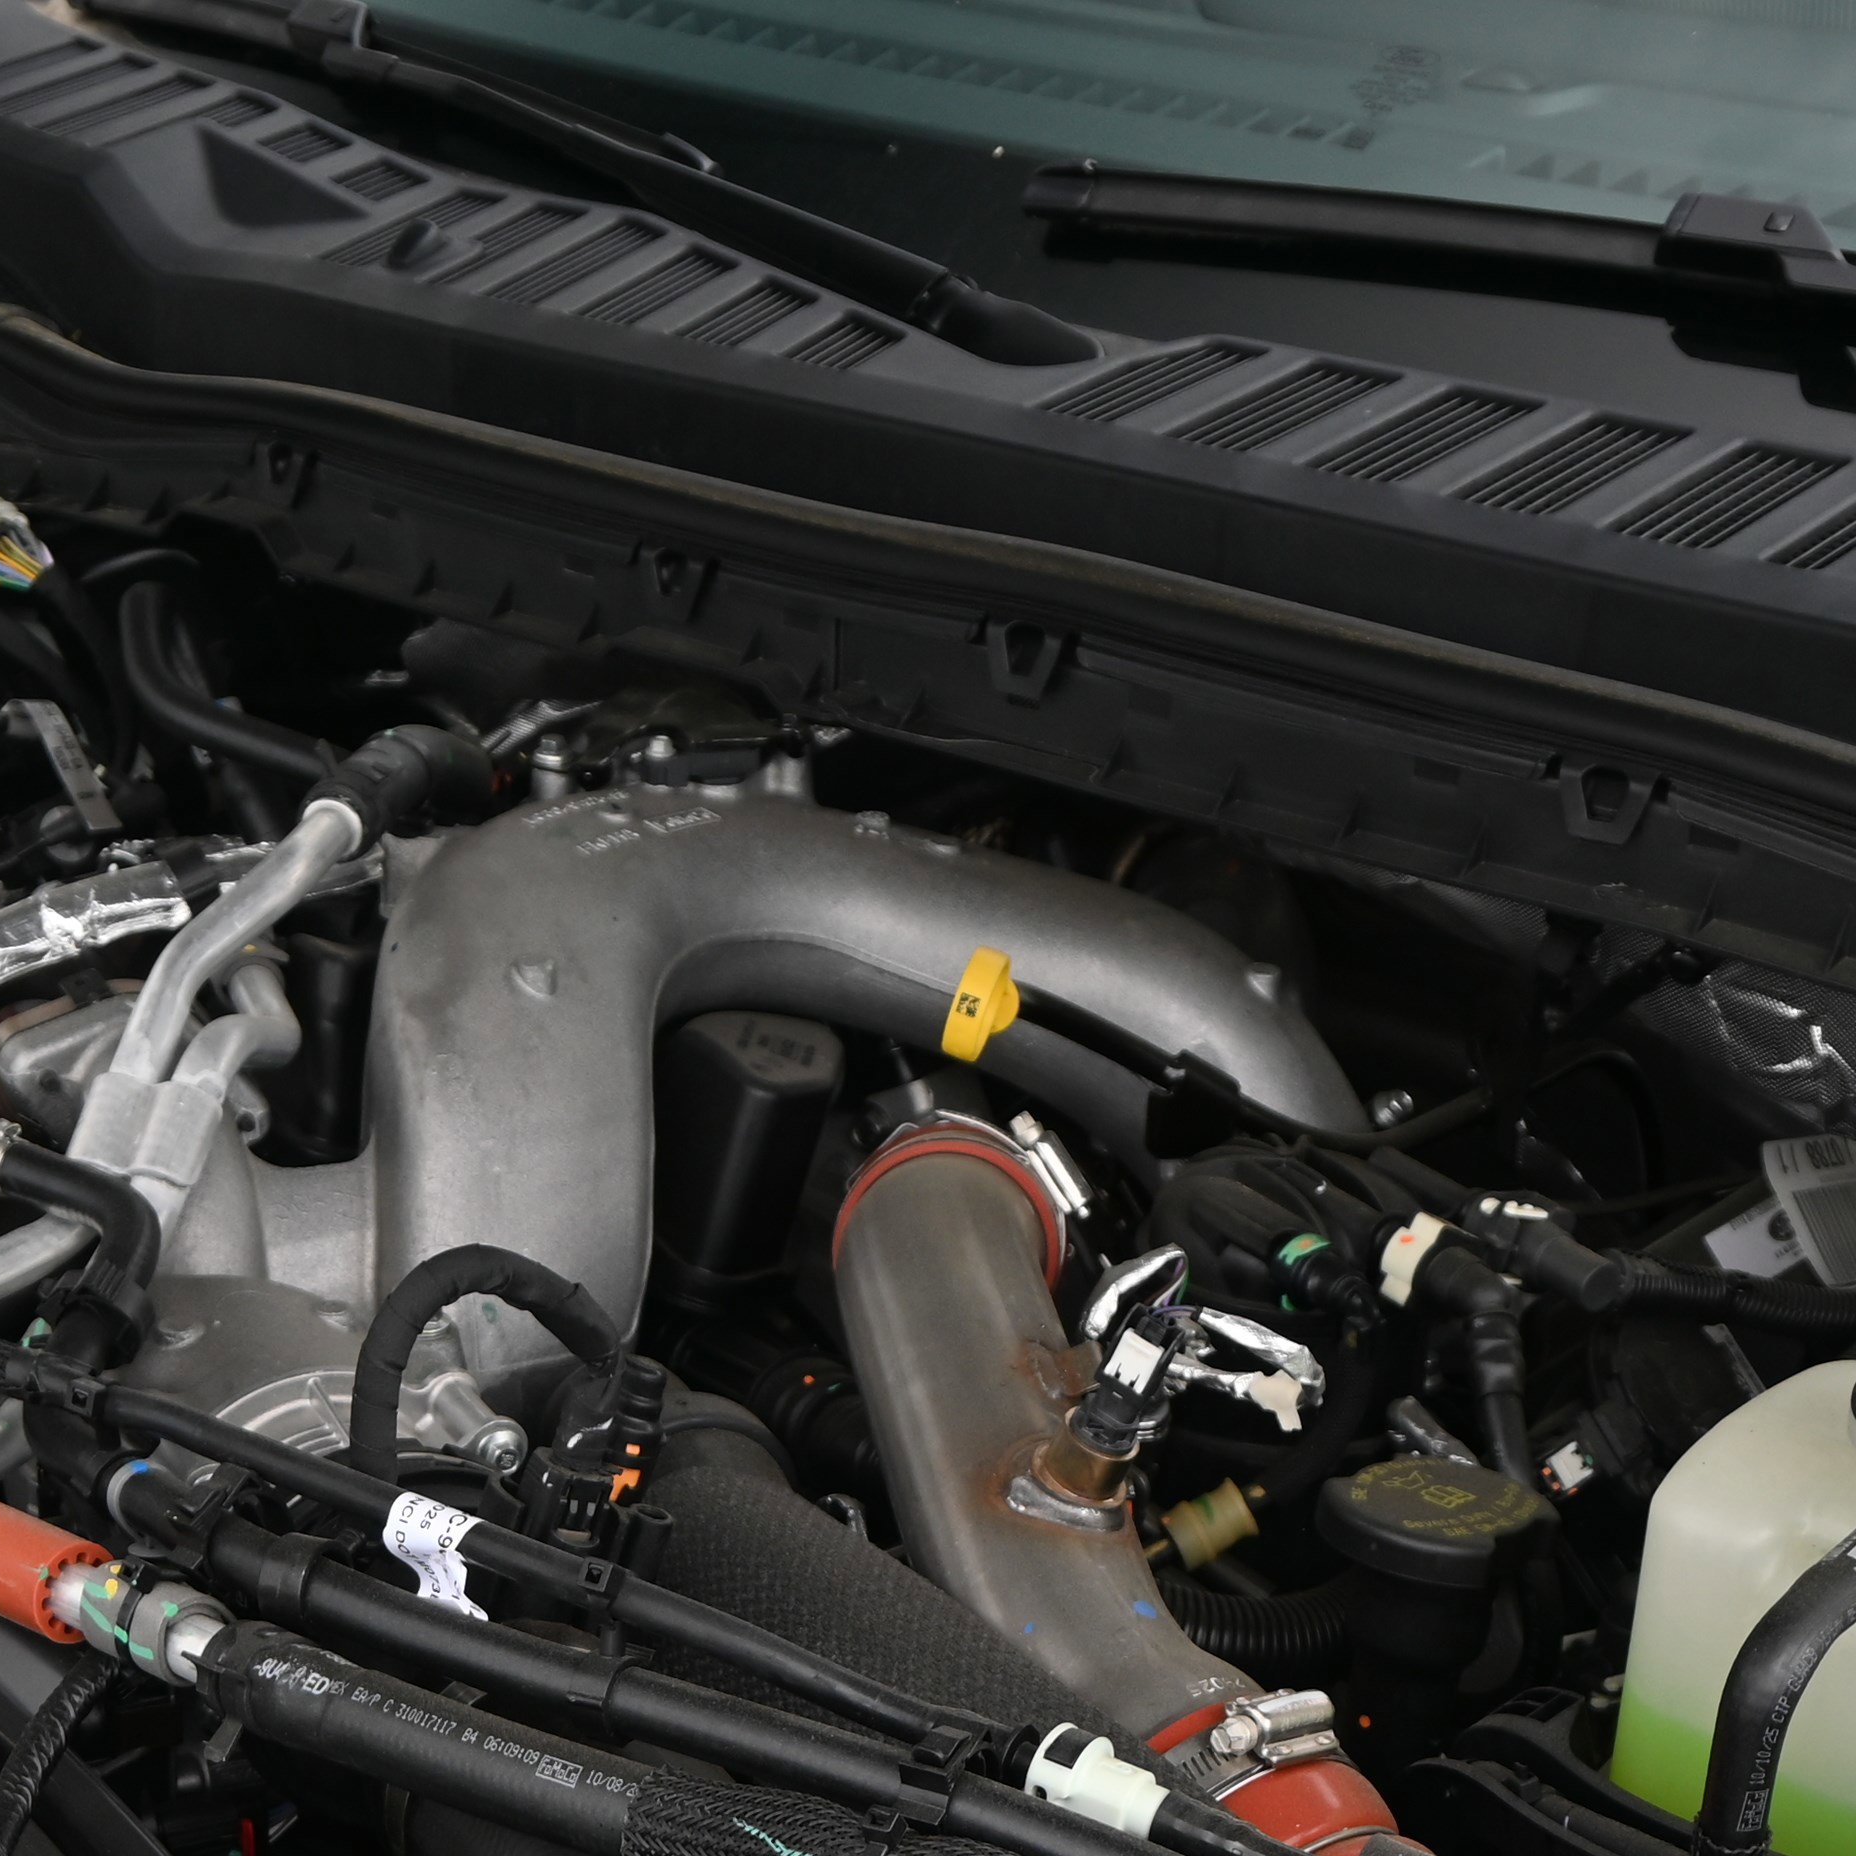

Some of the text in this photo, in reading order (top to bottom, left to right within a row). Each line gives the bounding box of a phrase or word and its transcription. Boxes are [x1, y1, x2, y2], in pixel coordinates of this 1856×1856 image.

[394, 1700, 457, 1737] 310017117
[540, 1758, 582, 1787] FoMoCo
[1748, 1694, 1791, 1787] 10/10/25 CIP
